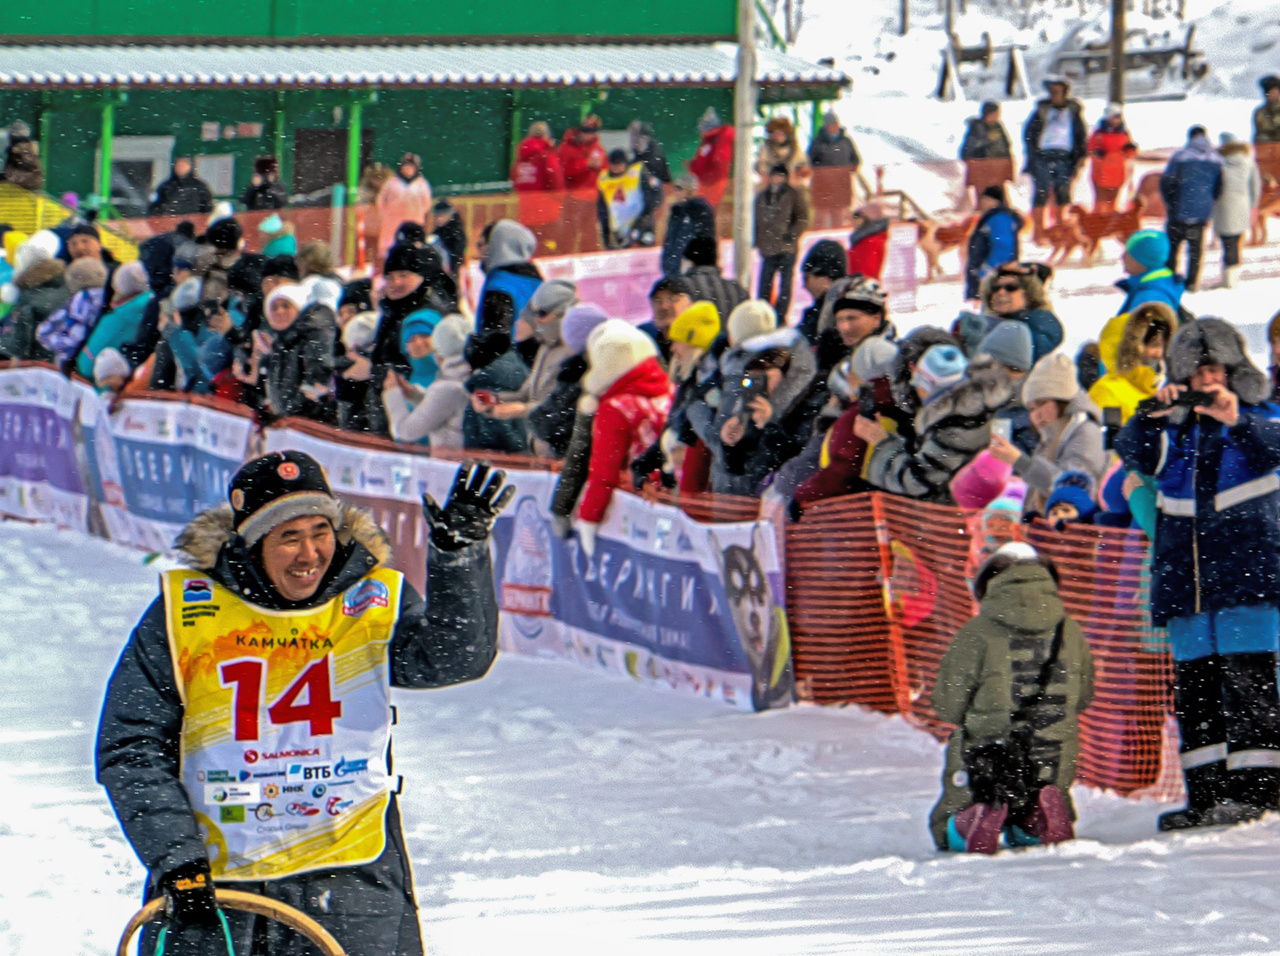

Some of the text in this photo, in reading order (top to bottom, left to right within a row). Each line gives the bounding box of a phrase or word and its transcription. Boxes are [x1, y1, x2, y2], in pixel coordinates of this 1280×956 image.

[235, 633, 335, 650] КАМЧАТКА
[219, 653, 343, 743] 14
[260, 747, 321, 760] SALMONICA
[302, 765, 332, 780] ВТБ
